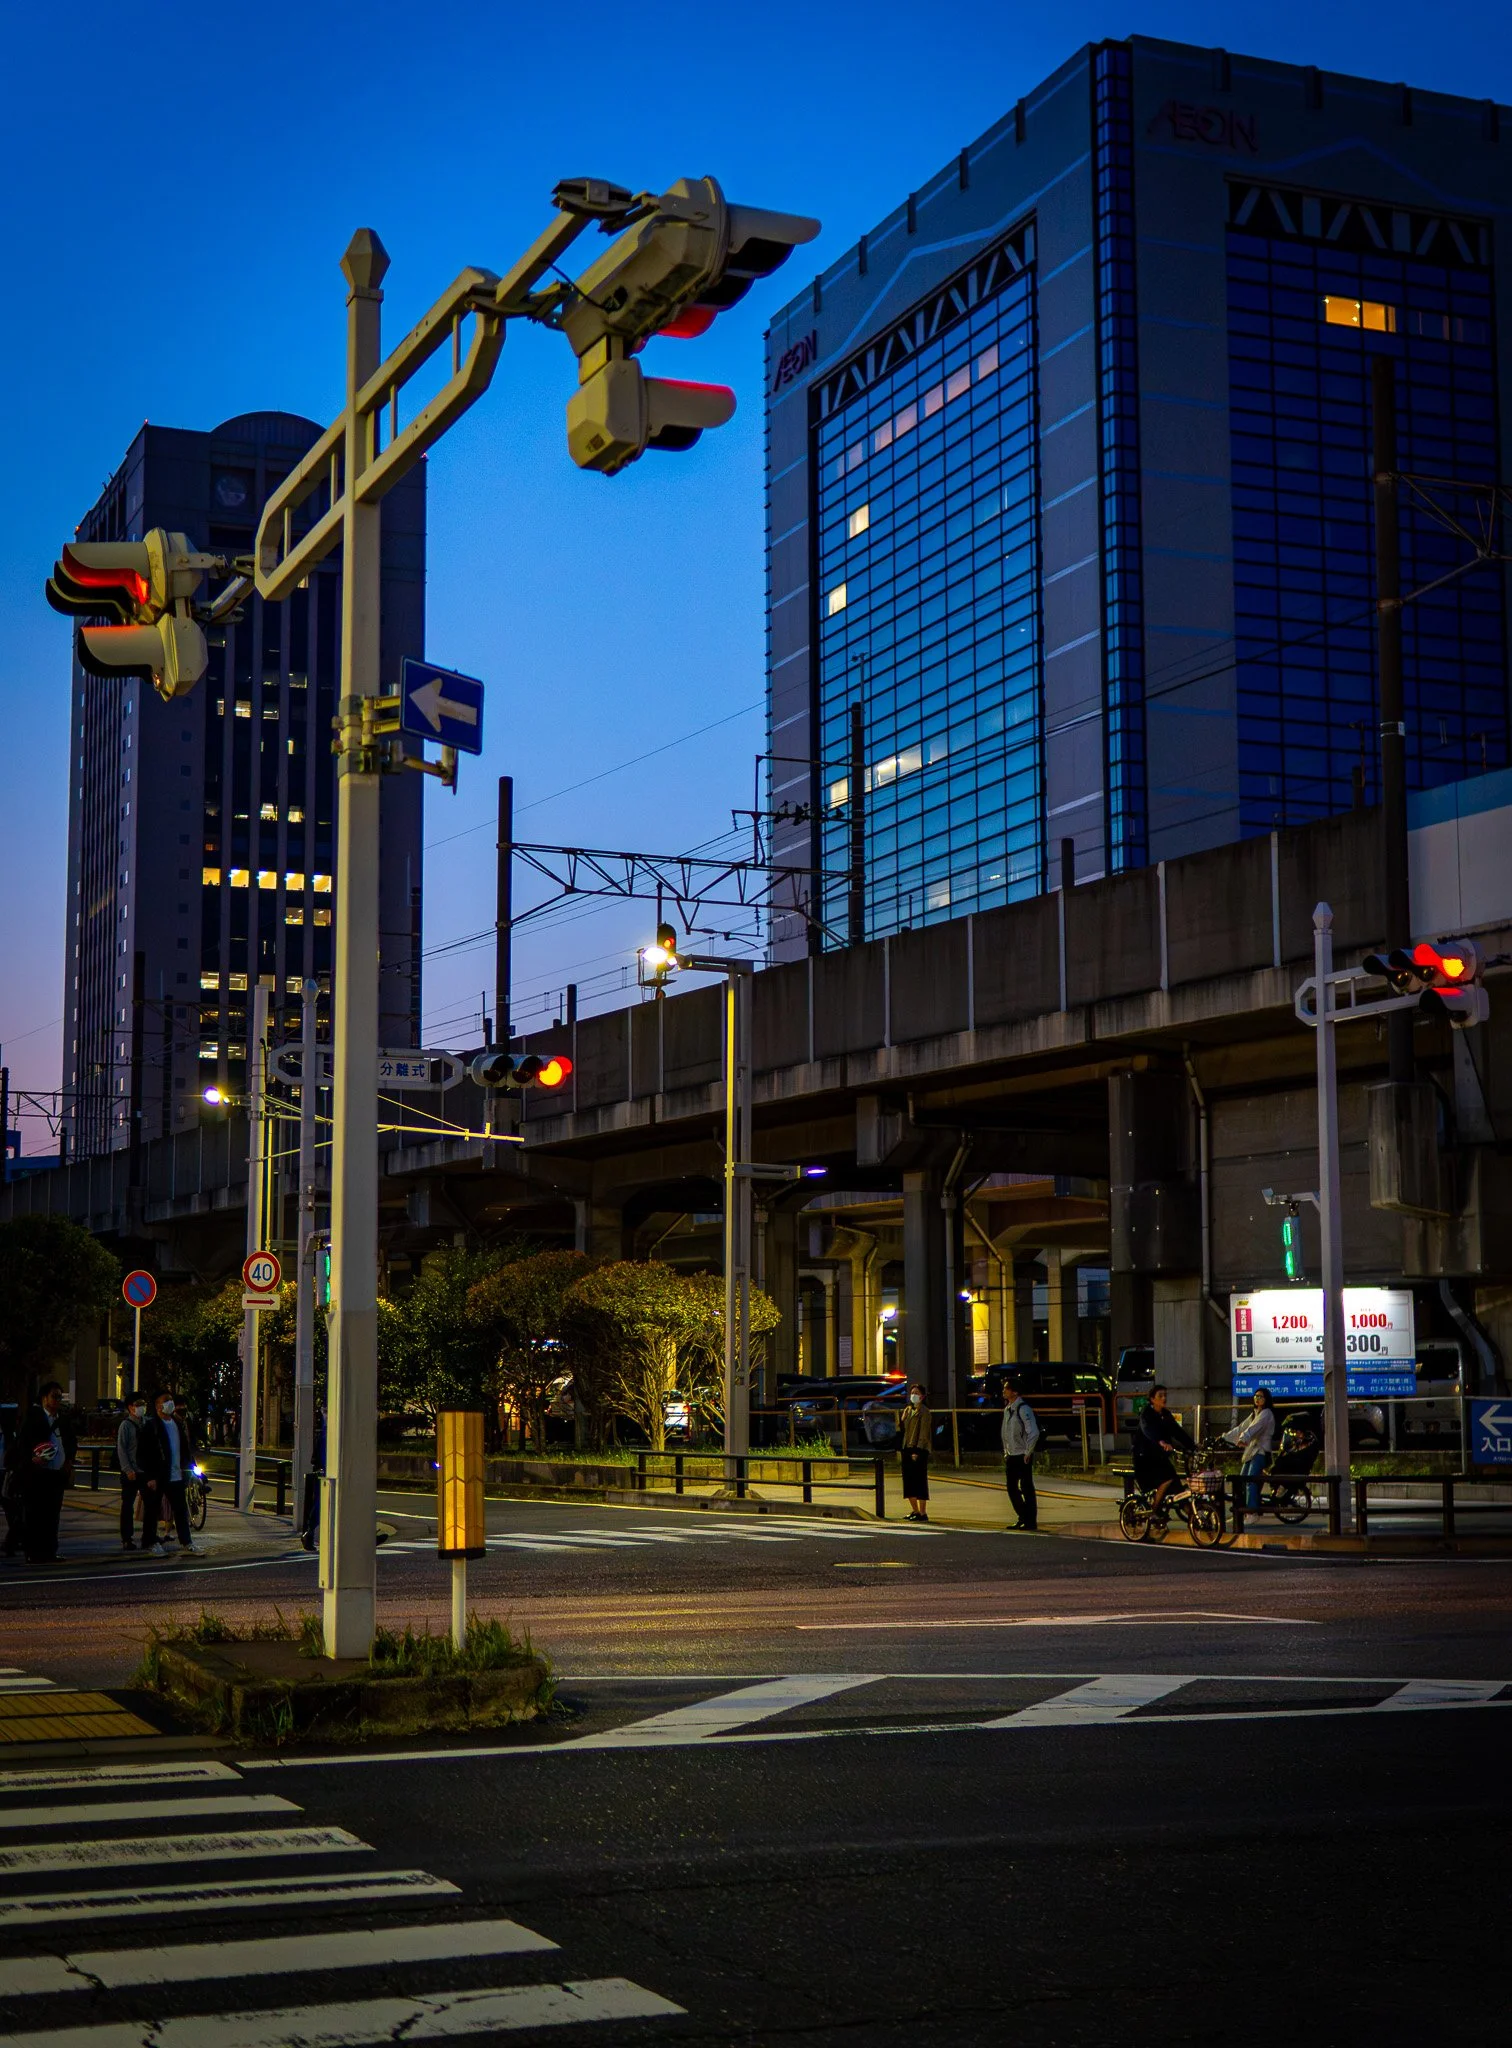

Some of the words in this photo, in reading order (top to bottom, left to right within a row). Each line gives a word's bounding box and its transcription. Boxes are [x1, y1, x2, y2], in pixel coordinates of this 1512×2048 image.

[773, 329, 817, 392] AEON
[380, 1062, 425, 1077] 分離式
[252, 1263, 272, 1281] 40
[1481, 1437, 1511, 1452] 入口
